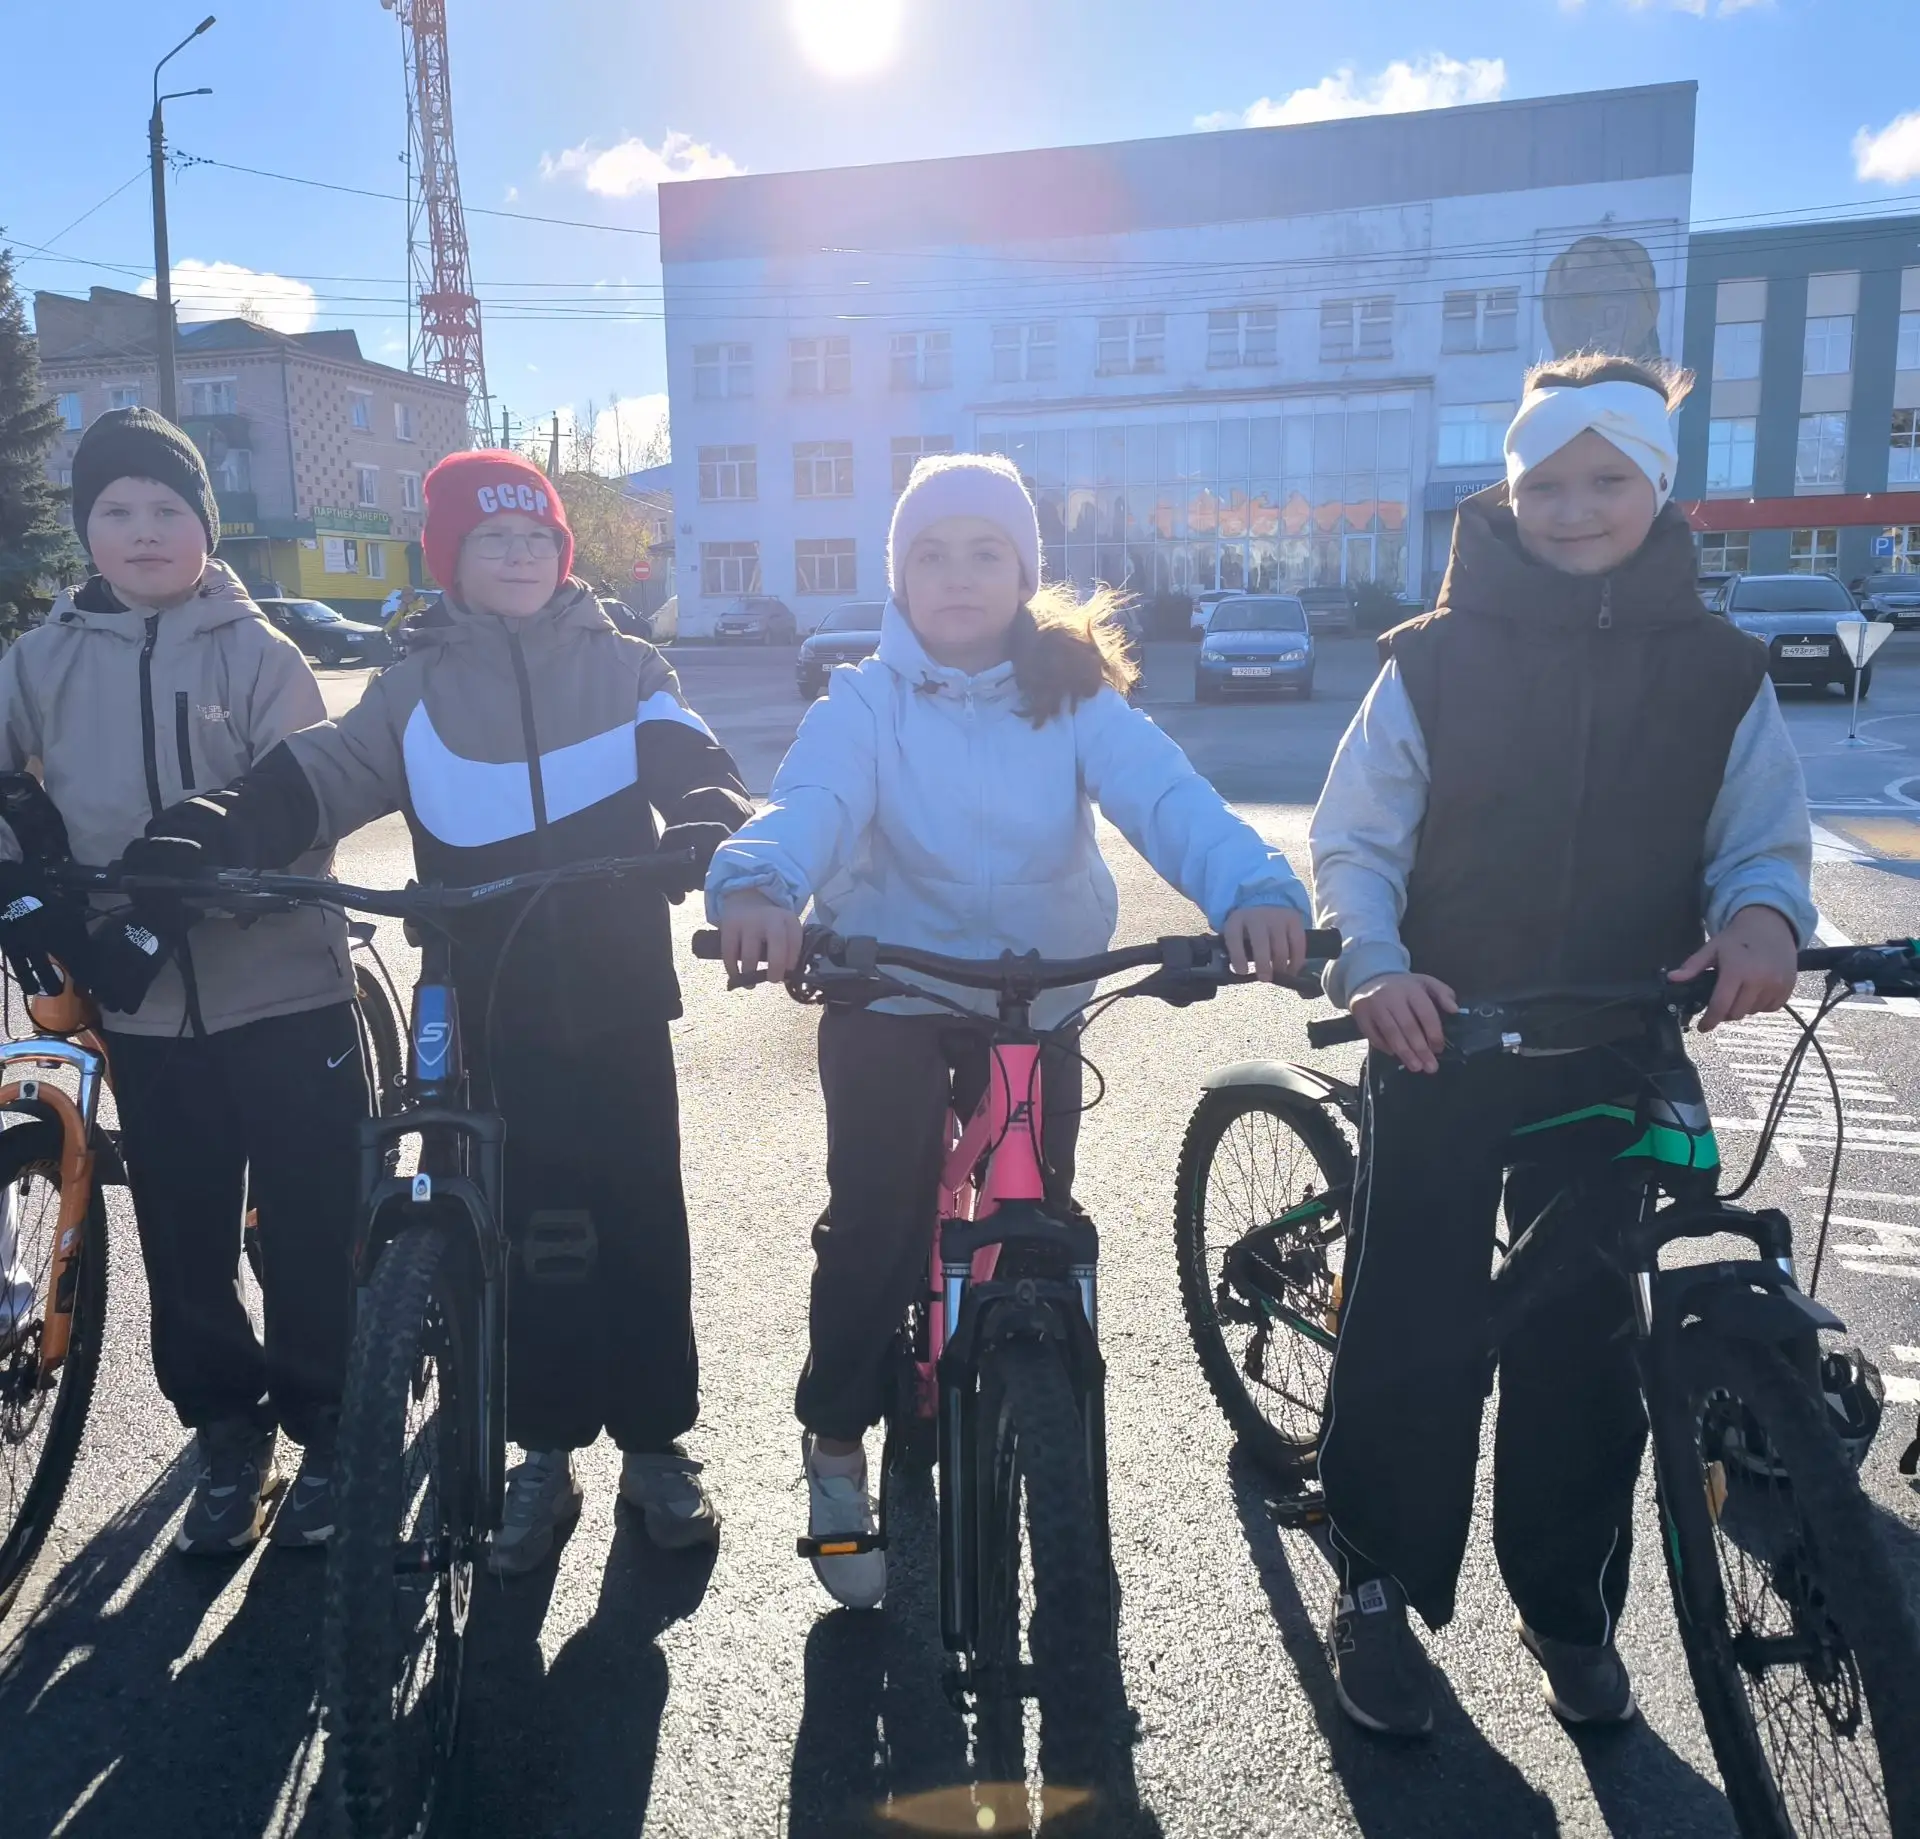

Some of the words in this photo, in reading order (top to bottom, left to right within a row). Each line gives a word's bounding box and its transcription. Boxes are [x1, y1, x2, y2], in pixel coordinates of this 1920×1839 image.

[477, 482, 548, 516] СССР
[1875, 537, 1889, 556] P
[124, 923, 149, 943] NORTH
[125, 931, 145, 948] FACE
